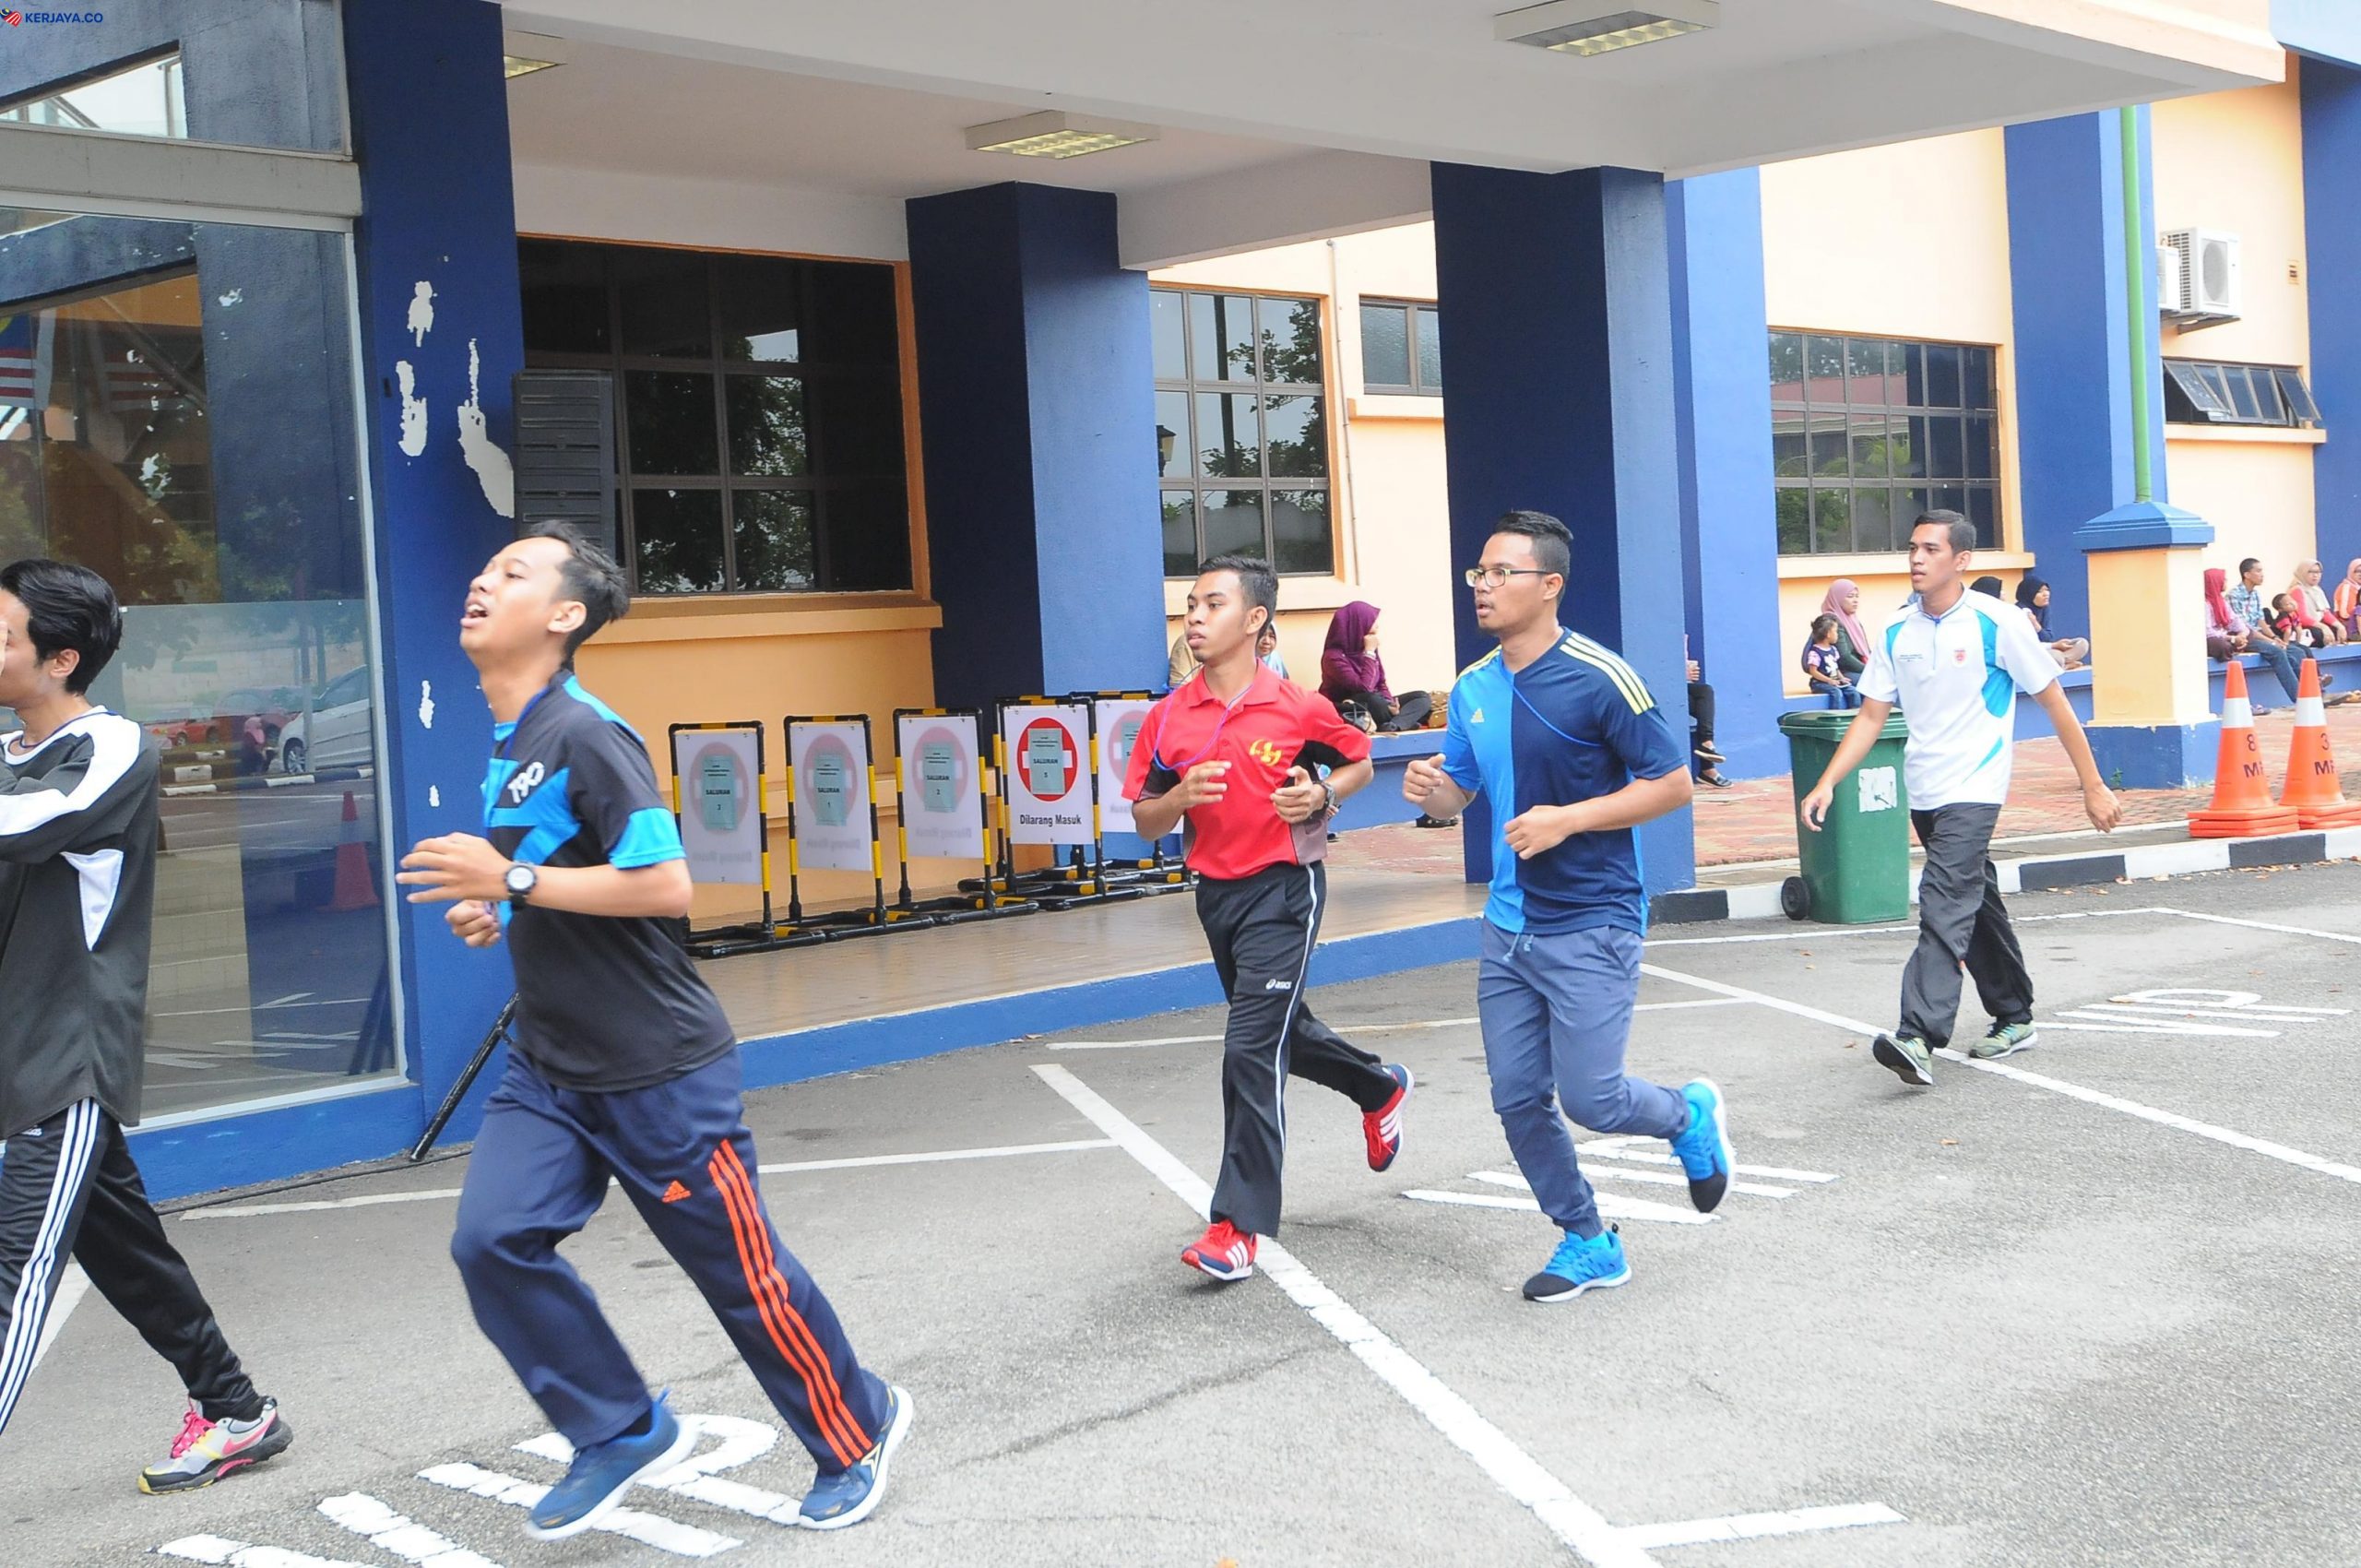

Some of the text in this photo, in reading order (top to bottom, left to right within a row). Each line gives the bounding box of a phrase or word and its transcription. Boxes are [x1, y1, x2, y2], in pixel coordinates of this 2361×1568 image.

[2247, 733, 2256, 752] 8
[2320, 732, 2331, 751] 3
[1019, 814, 1082, 827] Dilarang Masuk
